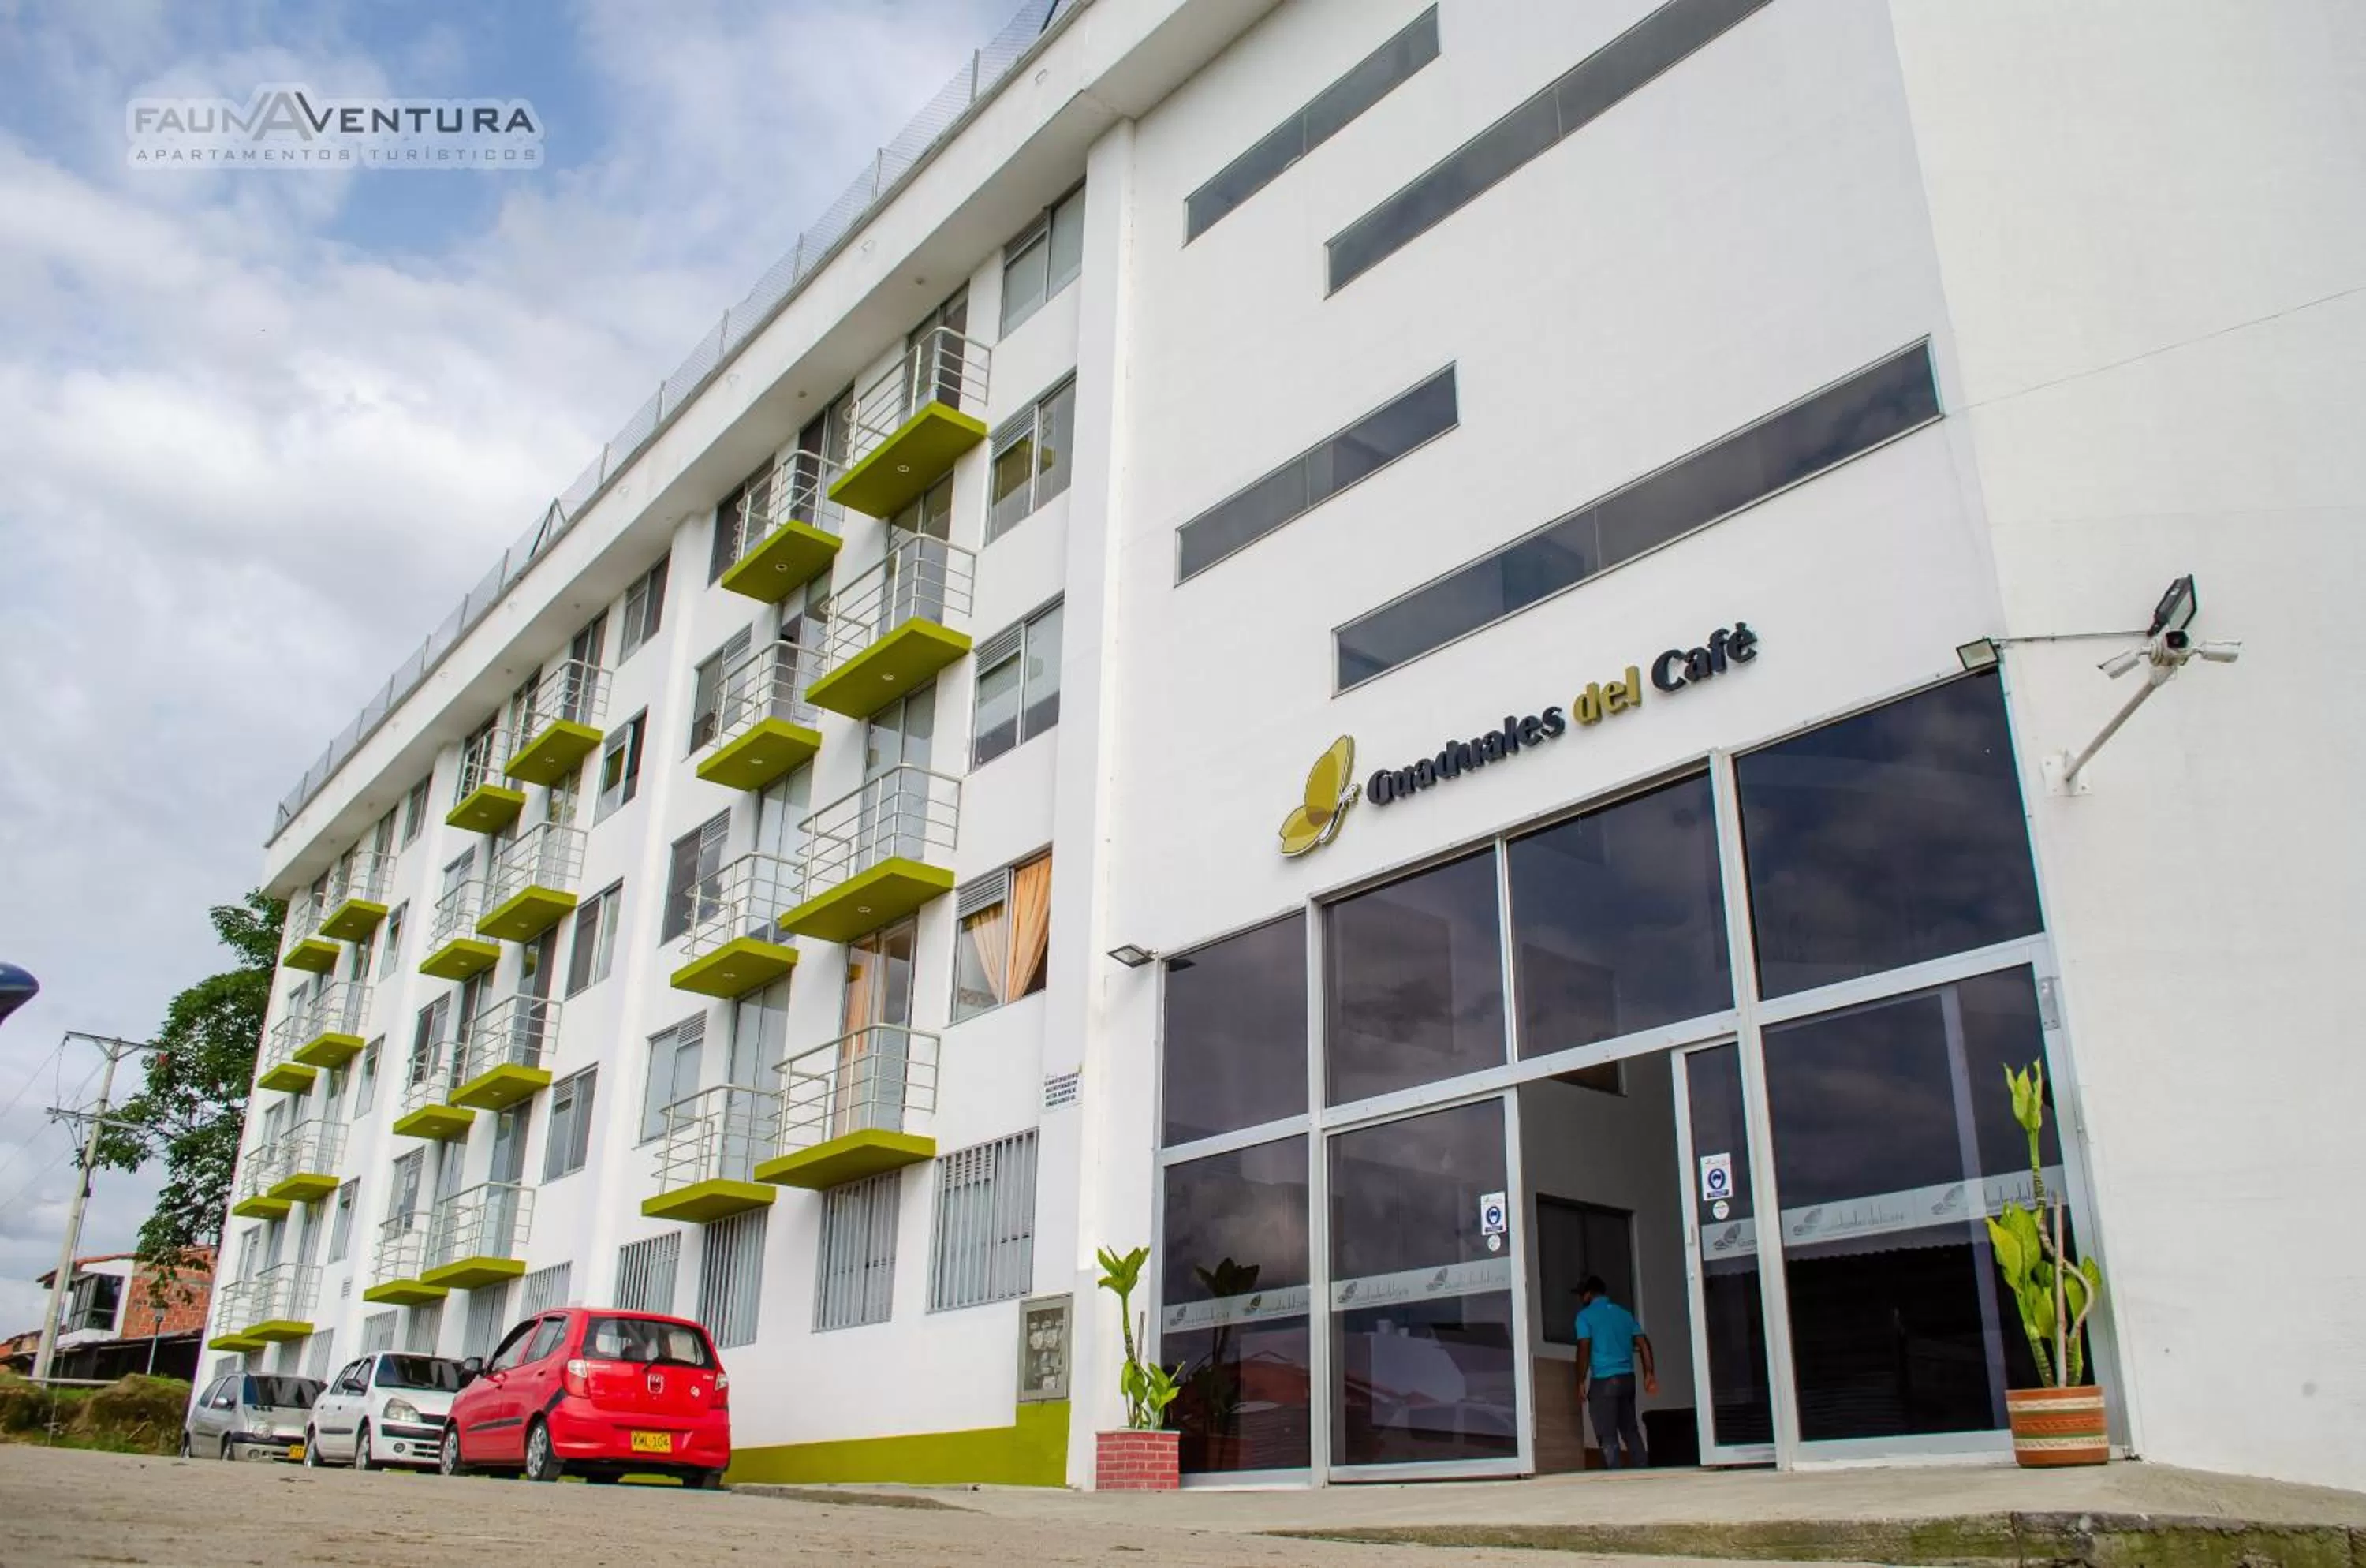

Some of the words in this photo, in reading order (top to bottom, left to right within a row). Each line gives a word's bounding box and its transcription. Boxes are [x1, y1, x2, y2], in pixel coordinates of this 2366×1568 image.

[1367, 706, 1566, 805] Guaduales
[1573, 666, 1642, 726] del
[1651, 622, 1758, 693] Café
